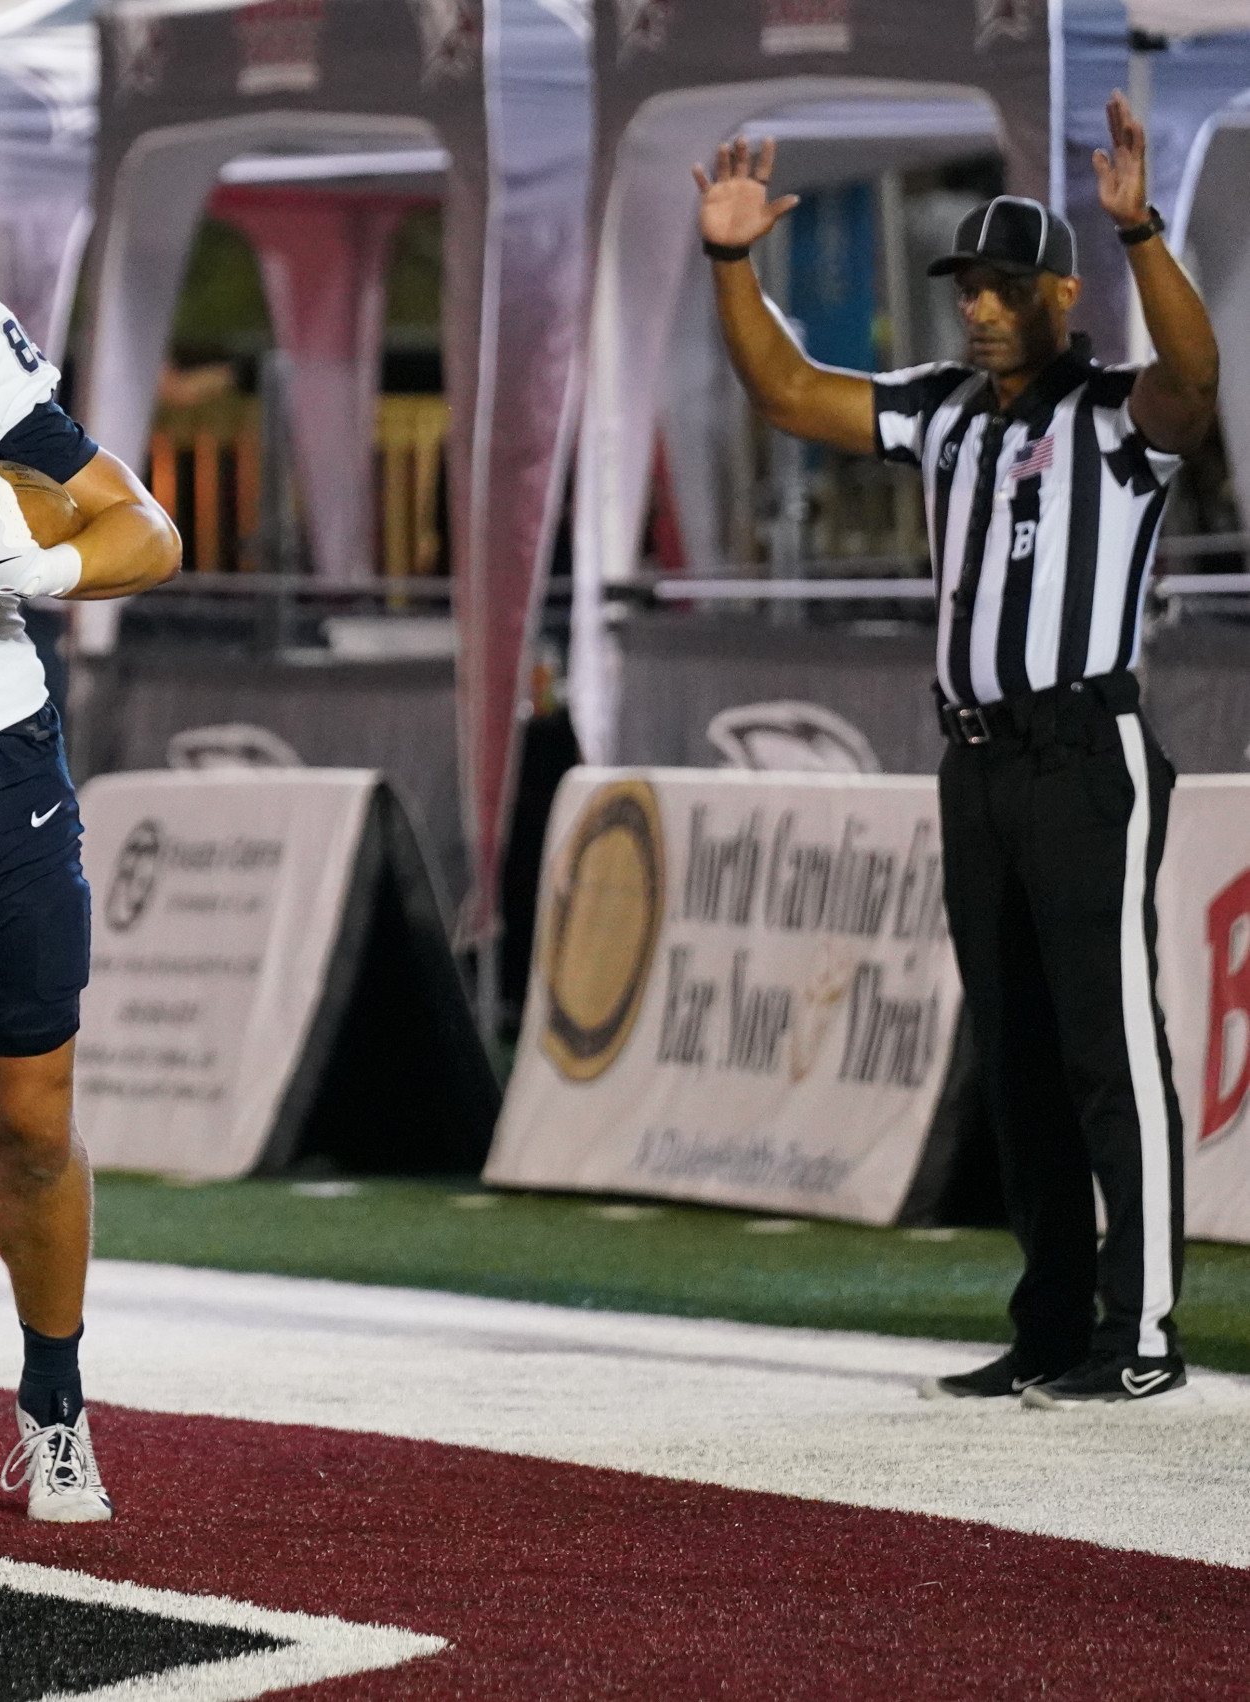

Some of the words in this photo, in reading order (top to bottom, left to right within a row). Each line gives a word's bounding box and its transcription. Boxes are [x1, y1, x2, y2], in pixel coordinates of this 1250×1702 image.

[1011, 519, 1037, 560] B
[682, 803, 763, 926] North
[763, 808, 895, 936] Carolina
[1197, 866, 1250, 1142] B
